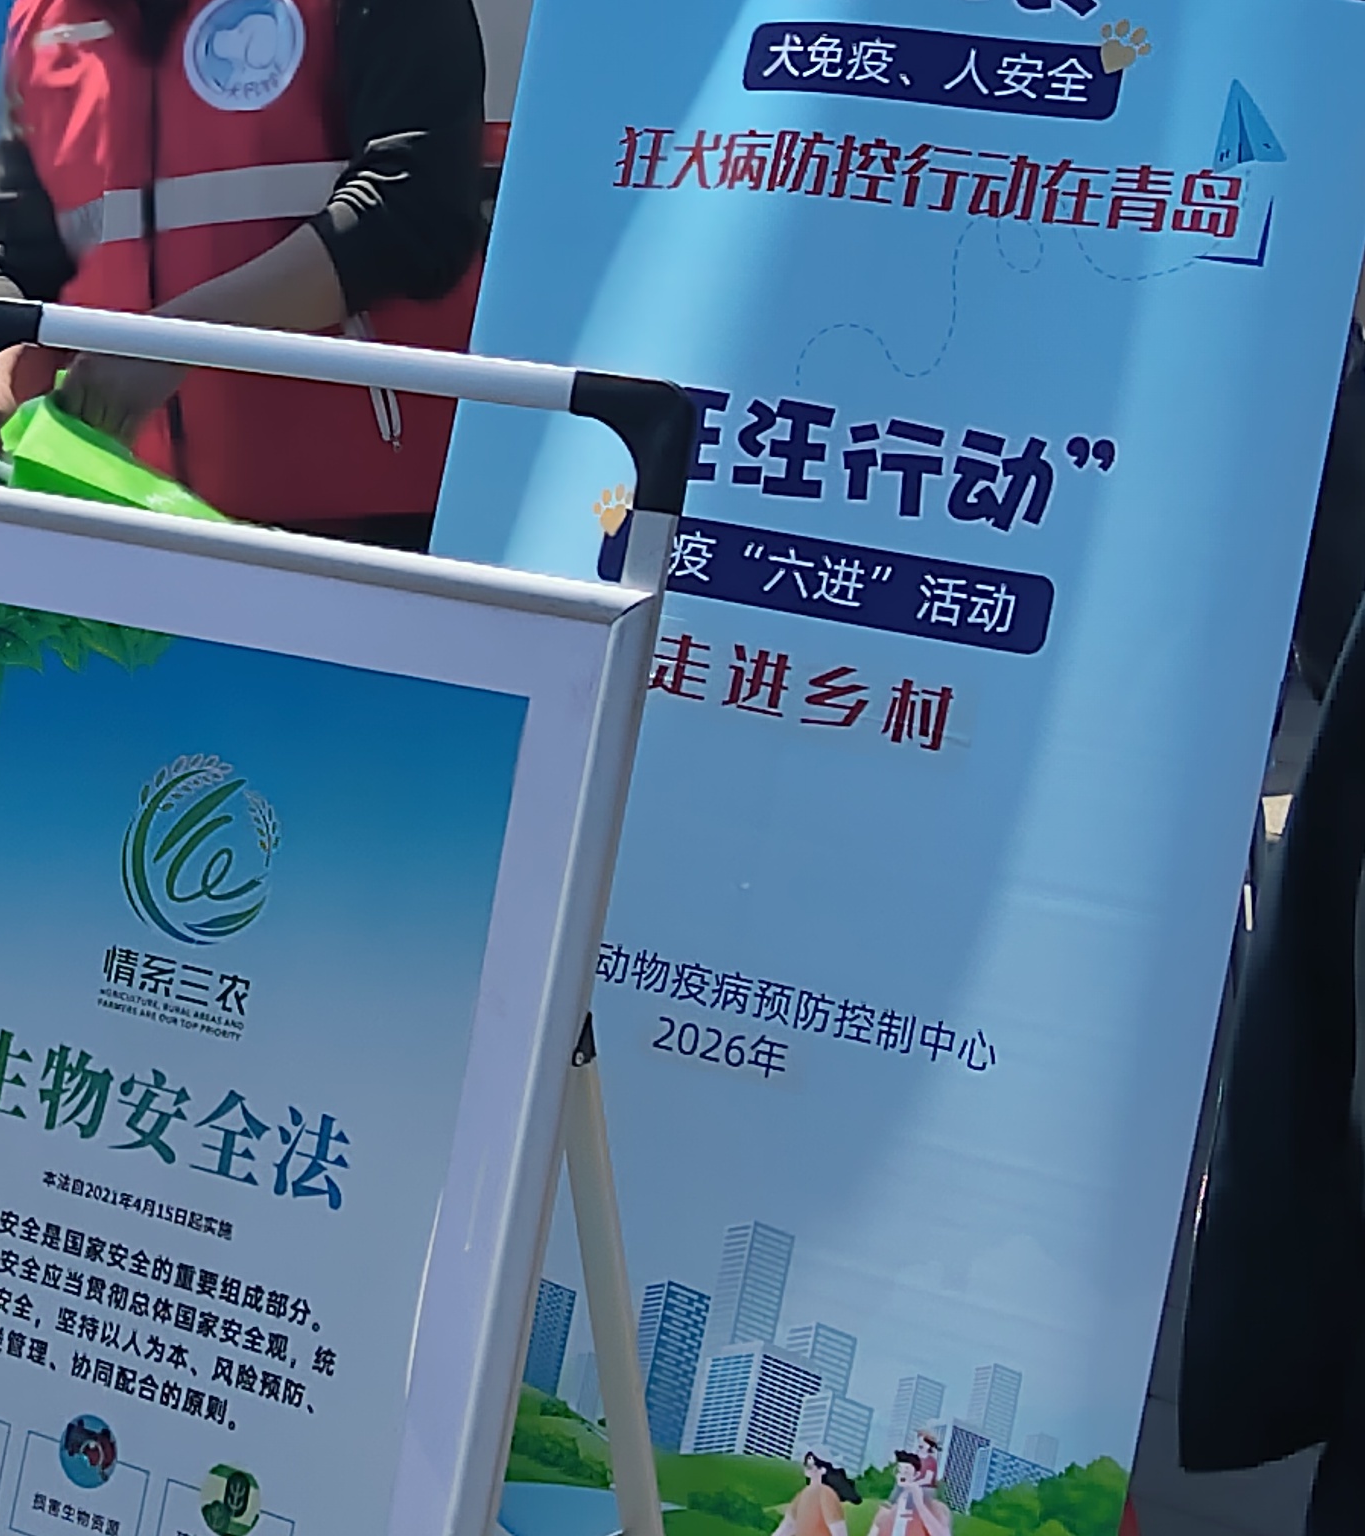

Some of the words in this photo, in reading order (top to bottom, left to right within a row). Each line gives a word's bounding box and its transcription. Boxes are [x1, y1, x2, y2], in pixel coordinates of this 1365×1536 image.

[762, 34, 1094, 104] 犬免疫、人安全
[612, 126, 1242, 239] 狂犬病防控行动在青岛
[650, 634, 955, 752] 走进乡村
[103, 944, 251, 1016] 情系三农
[594, 942, 997, 1073] 动物疫病预防控制中心
[652, 1015, 789, 1079] 2026年
[42, 1170, 234, 1241] 本法自2021年4月15日起实施
